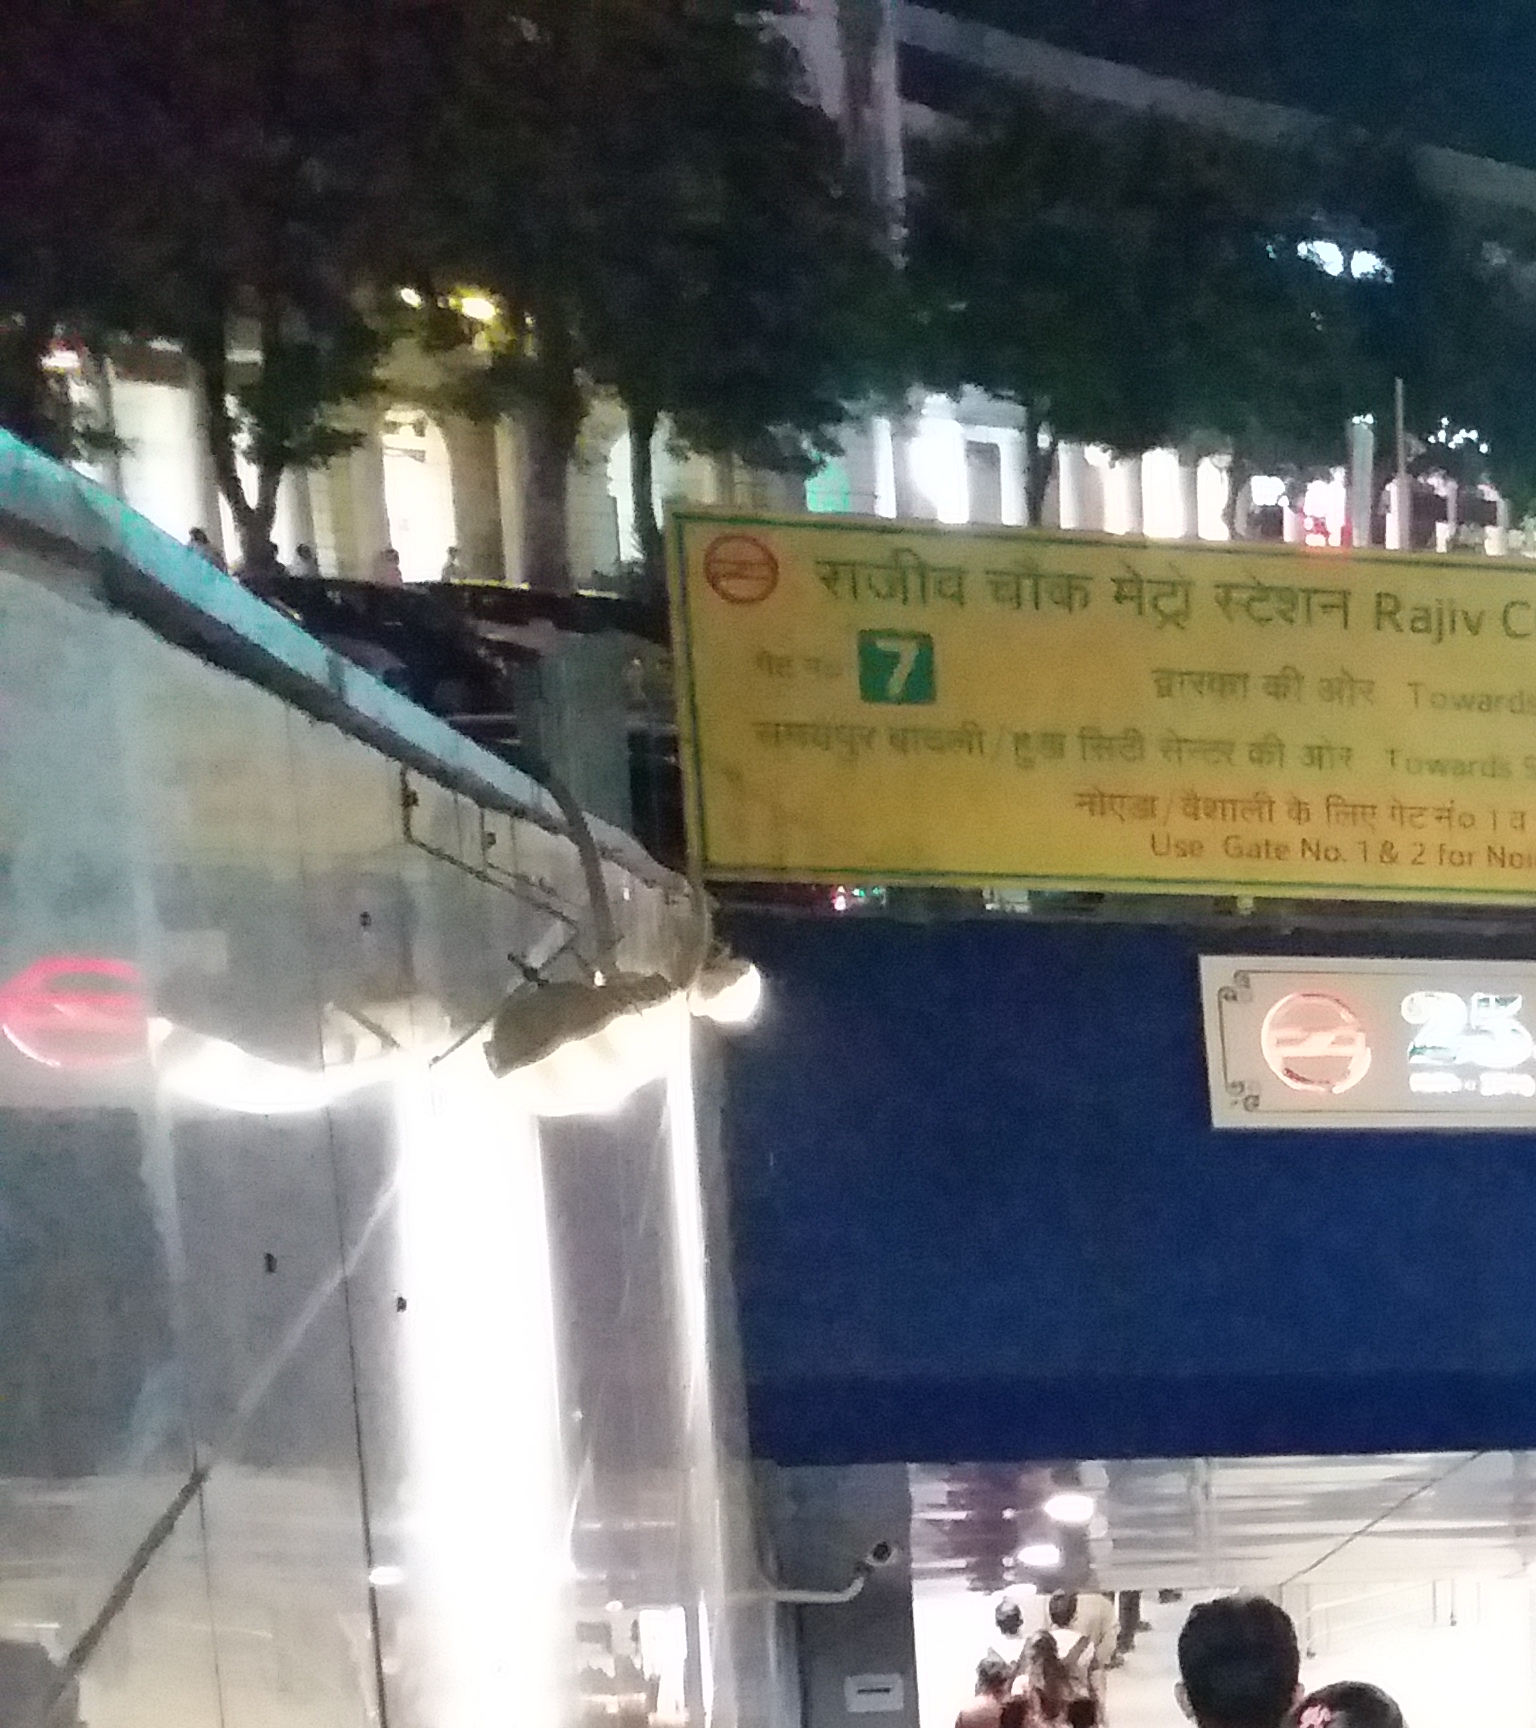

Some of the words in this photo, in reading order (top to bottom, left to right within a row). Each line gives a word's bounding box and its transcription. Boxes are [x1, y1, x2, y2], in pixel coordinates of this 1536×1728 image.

[815, 547, 966, 607] राजीव
[985, 556, 1094, 614] चौक
[1110, 560, 1195, 631] मेट्रो
[1214, 573, 1351, 631] स्टेशन
[1375, 591, 1486, 645] Rajiv
[874, 637, 921, 697] 7
[1261, 665, 1304, 701] की
[1319, 664, 1375, 706] ओर
[1386, 748, 1513, 779] Towards
[1151, 833, 1204, 858] Use
[1223, 834, 1290, 861] Gate
[1301, 836, 1347, 863] No.
[1357, 840, 1368, 863] 1
[1378, 839, 1399, 865] &
[1410, 842, 1426, 866] 2
[1438, 843, 1474, 867] for
